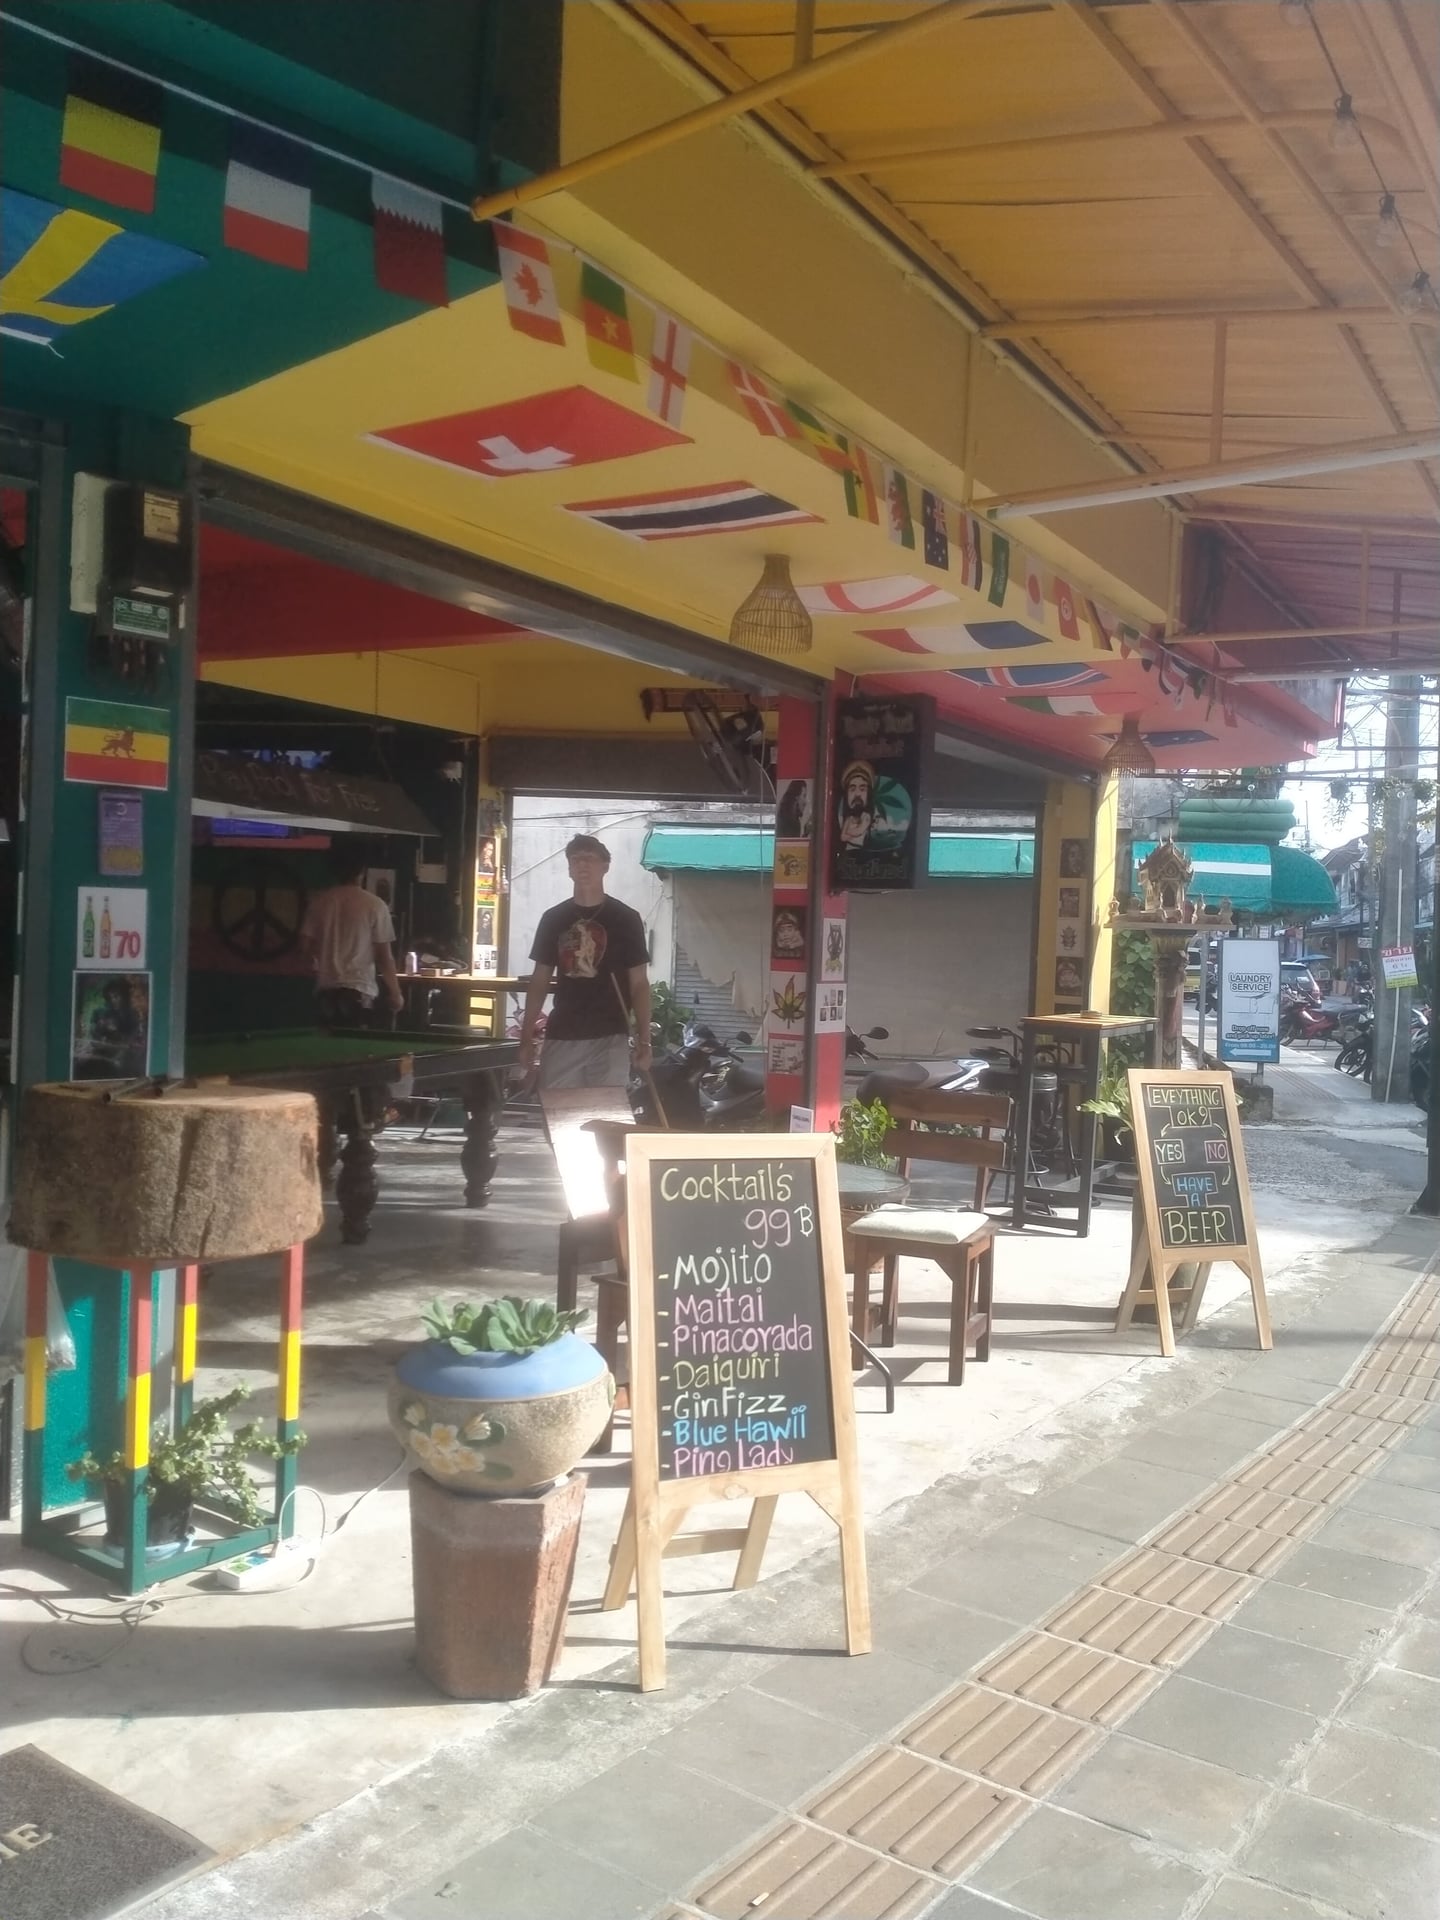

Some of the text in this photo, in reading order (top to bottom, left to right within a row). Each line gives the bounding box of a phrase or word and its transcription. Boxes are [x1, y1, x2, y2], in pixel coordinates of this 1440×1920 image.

[114, 930, 142, 959] 70
[1230, 973, 1271, 982] LAUNDRY
[1231, 982, 1270, 991] SERVICE
[1152, 1088, 1219, 1106] EVEYTHING
[1155, 1143, 1227, 1162] YES NO
[660, 1162, 793, 1203] Cocktail's
[1176, 1176, 1213, 1193] HAVE
[1190, 1193, 1201, 1207] A
[1164, 1210, 1227, 1245] BEER
[735, 1404, 807, 1443] Hawii
